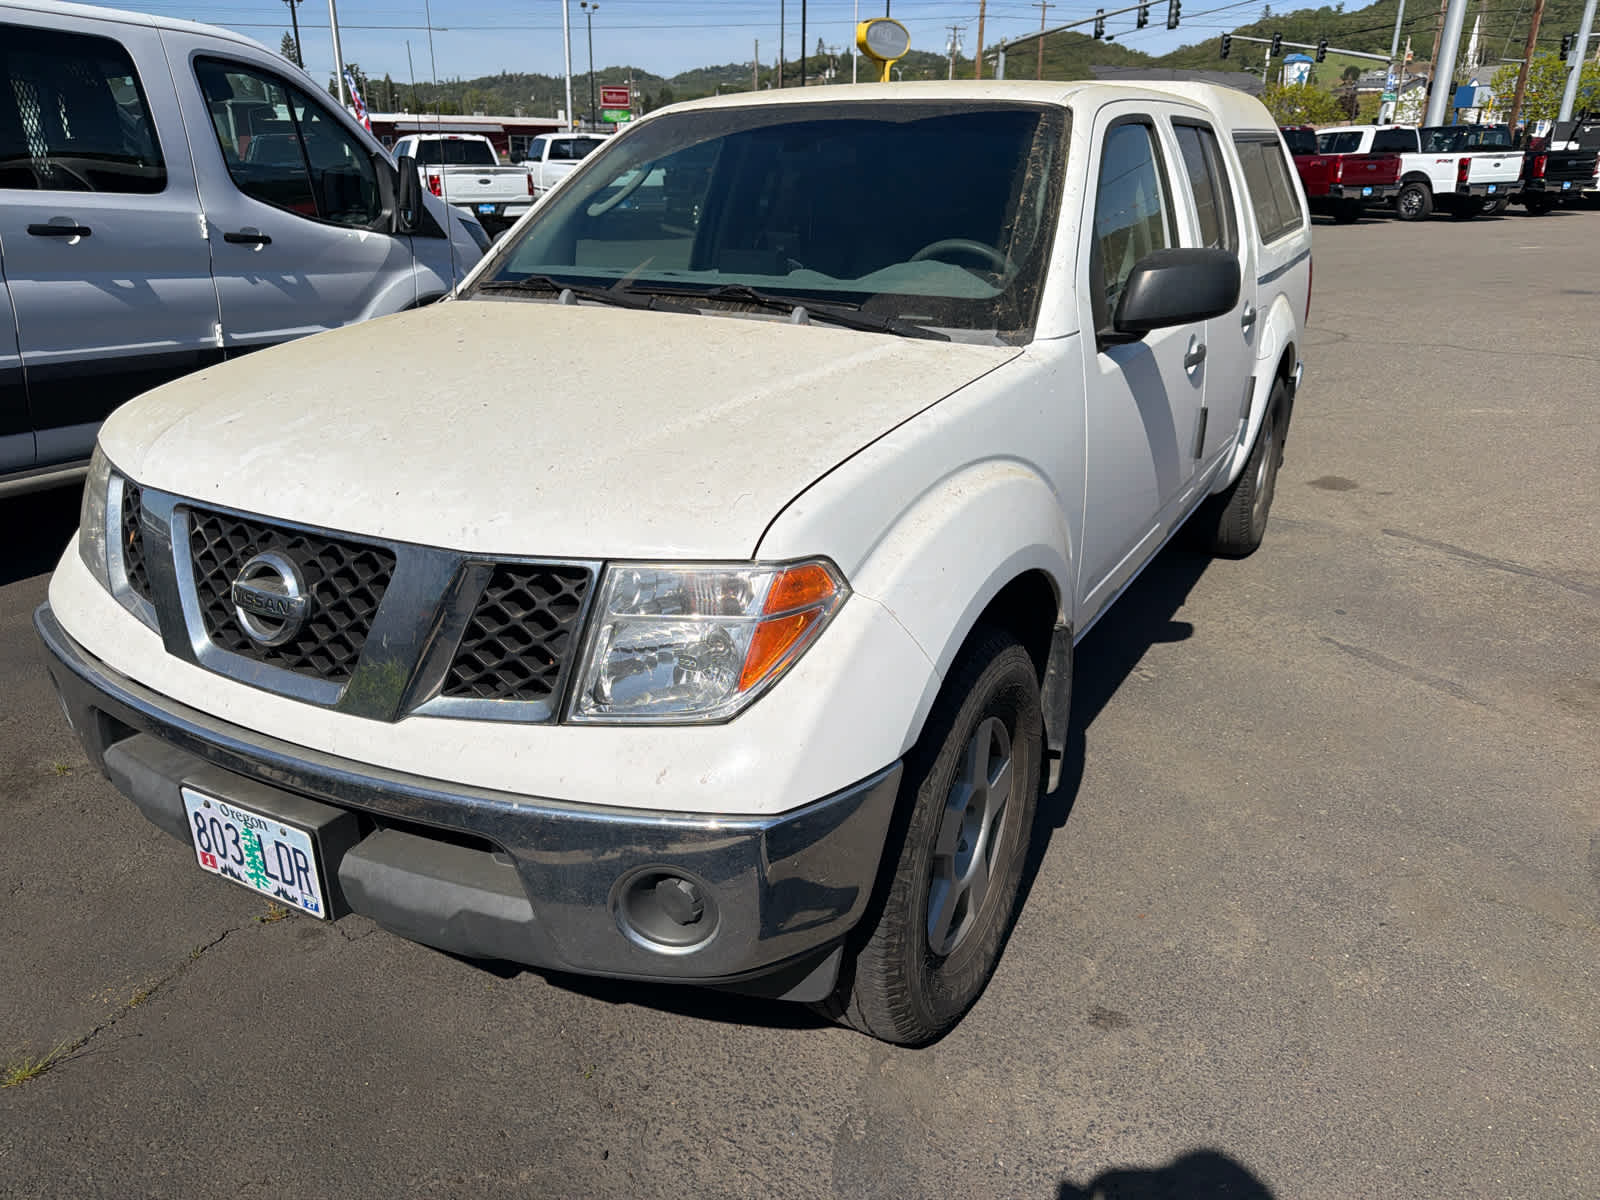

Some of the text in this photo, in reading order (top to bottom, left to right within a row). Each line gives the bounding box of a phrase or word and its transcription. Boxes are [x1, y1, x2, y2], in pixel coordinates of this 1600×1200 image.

[234, 590, 290, 614] NISSAN
[220, 803, 268, 832] Oregon
[194, 811, 313, 895] 803 LDR
[205, 854, 213, 866] 1
